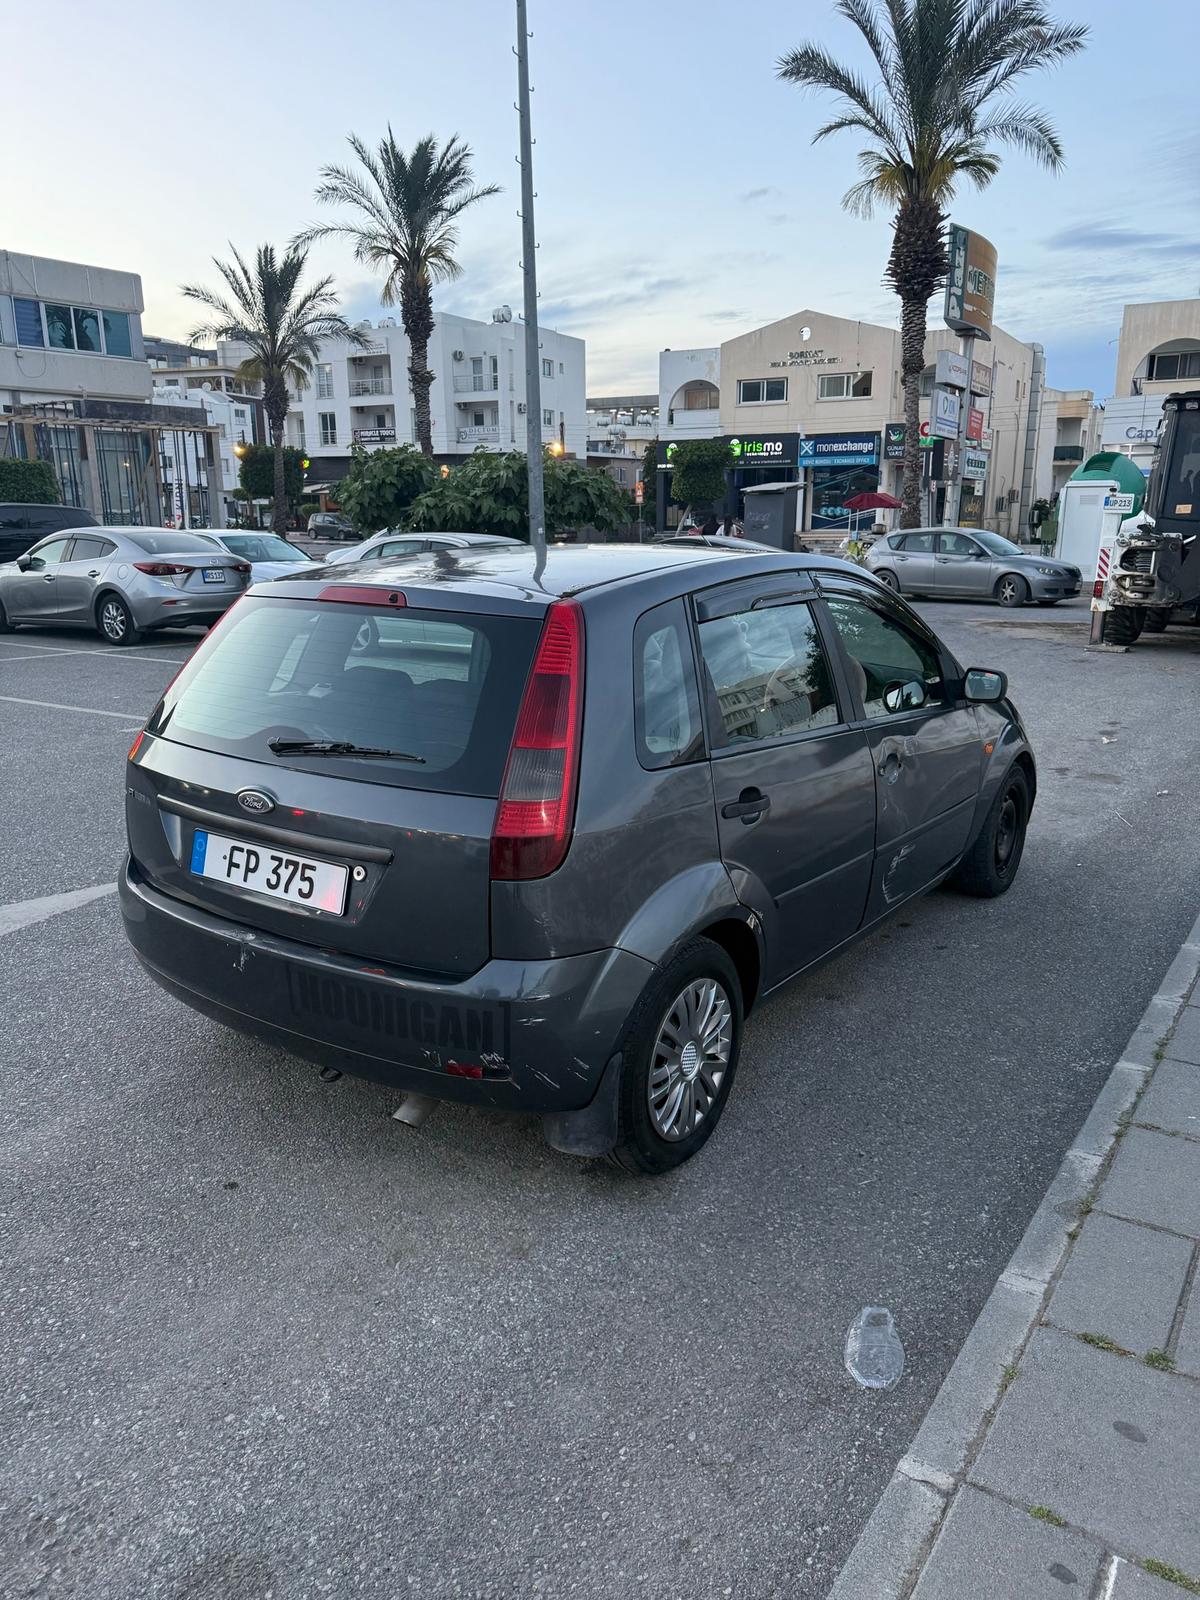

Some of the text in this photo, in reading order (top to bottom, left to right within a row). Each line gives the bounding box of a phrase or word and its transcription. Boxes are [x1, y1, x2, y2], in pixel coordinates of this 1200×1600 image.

[744, 441, 783, 452] irismo
[816, 441, 874, 453] monexchange
[244, 795, 263, 809] Ford
[227, 846, 317, 899] FP 375
